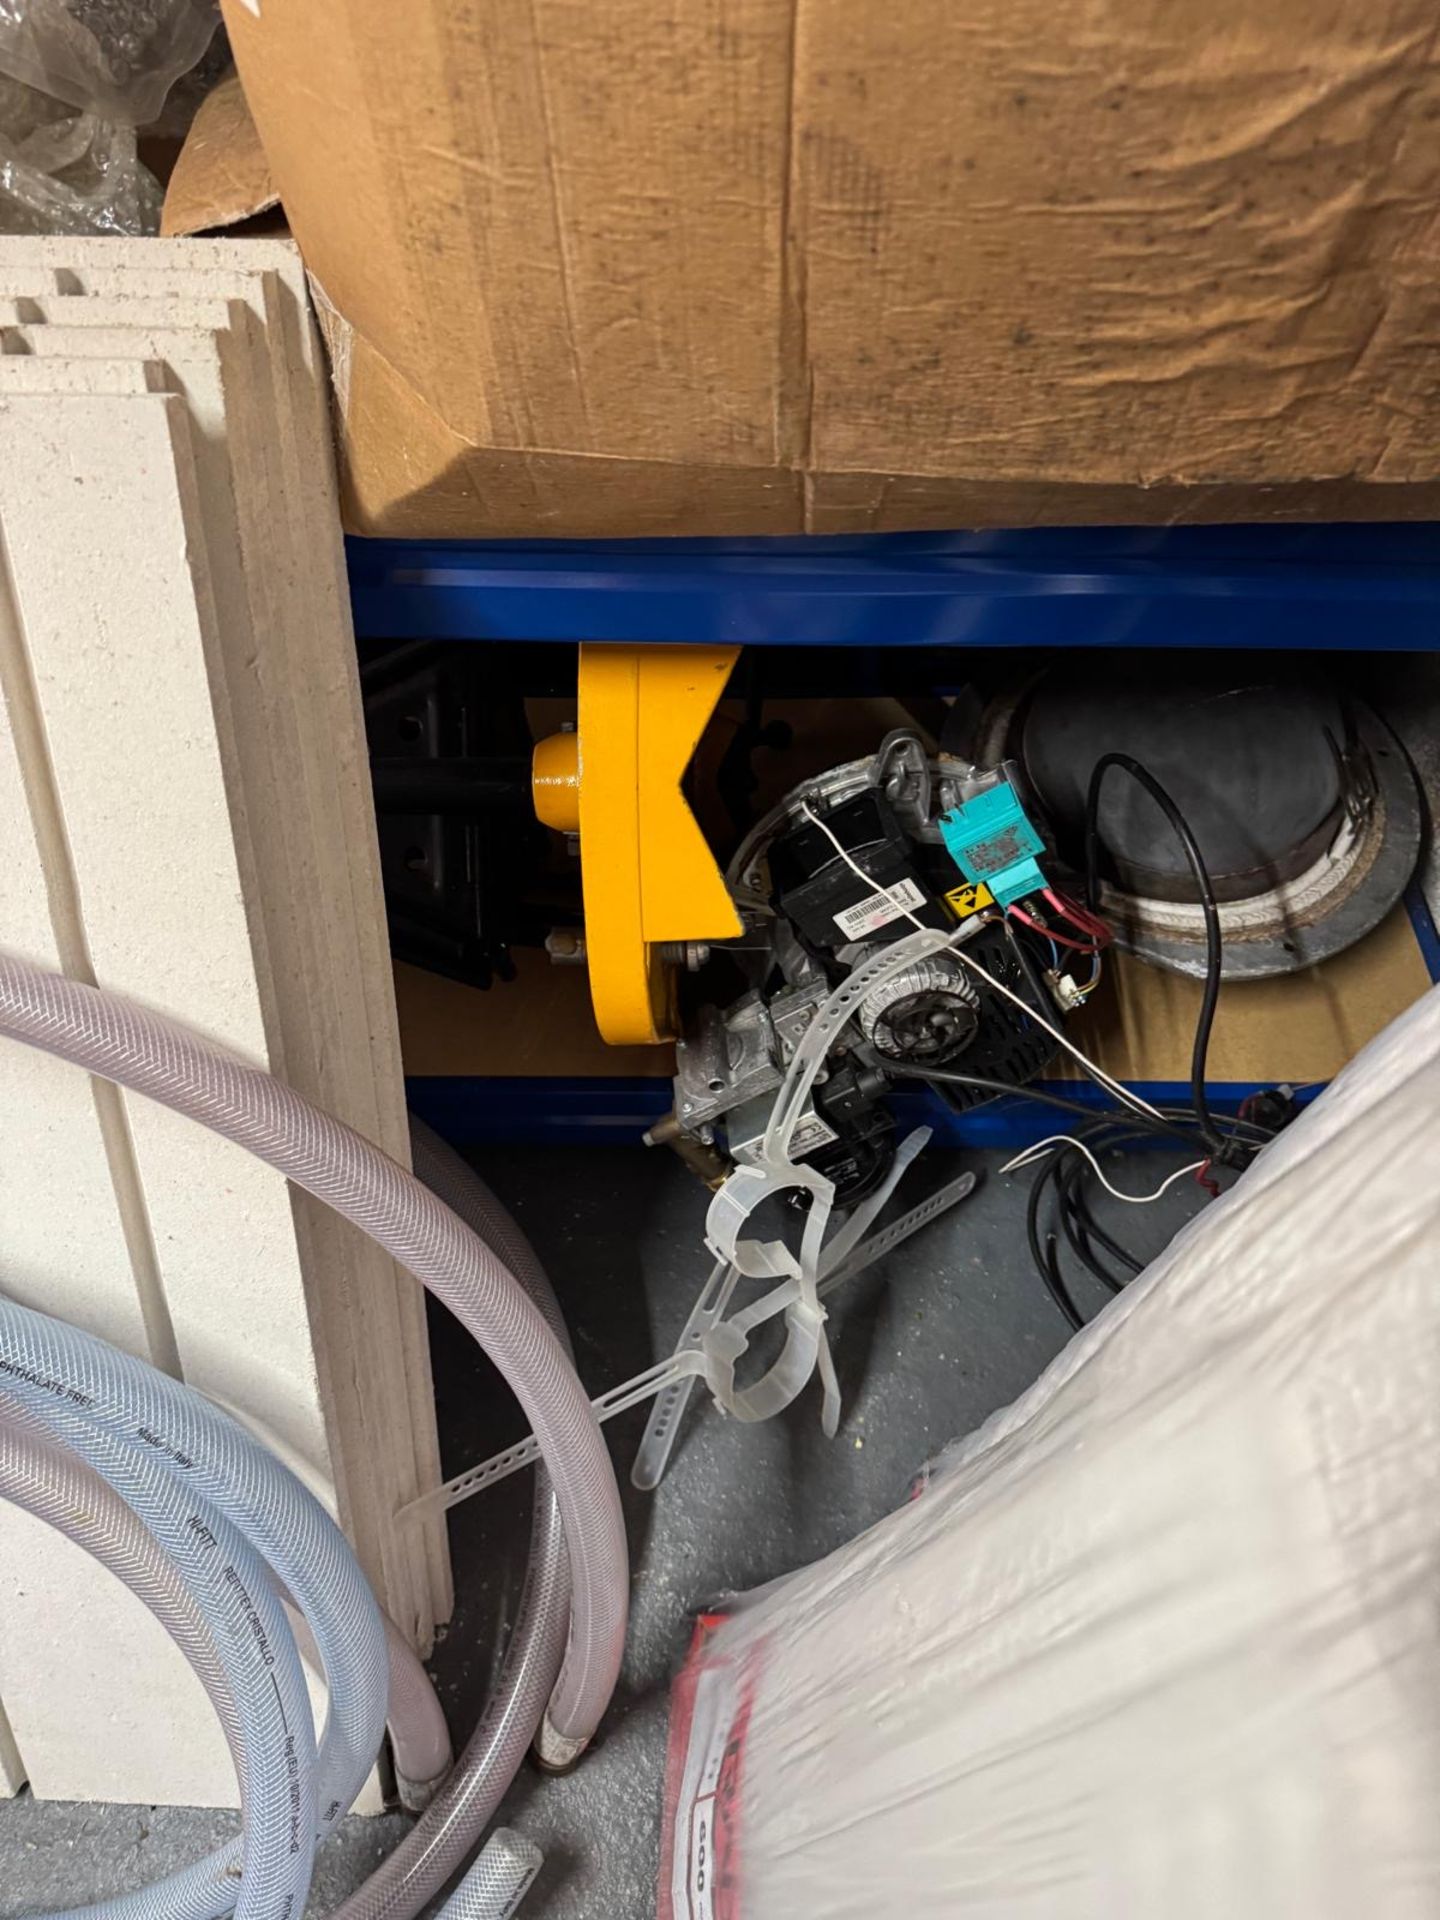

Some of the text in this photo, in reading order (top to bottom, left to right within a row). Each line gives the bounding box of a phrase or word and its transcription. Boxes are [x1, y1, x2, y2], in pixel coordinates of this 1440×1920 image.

[0, 1360, 68, 1396] PHTHALATE
[136, 1426, 162, 1449] Made
[172, 1450, 195, 1469] Italy
[246, 1610, 276, 1667] CRISTALLO
